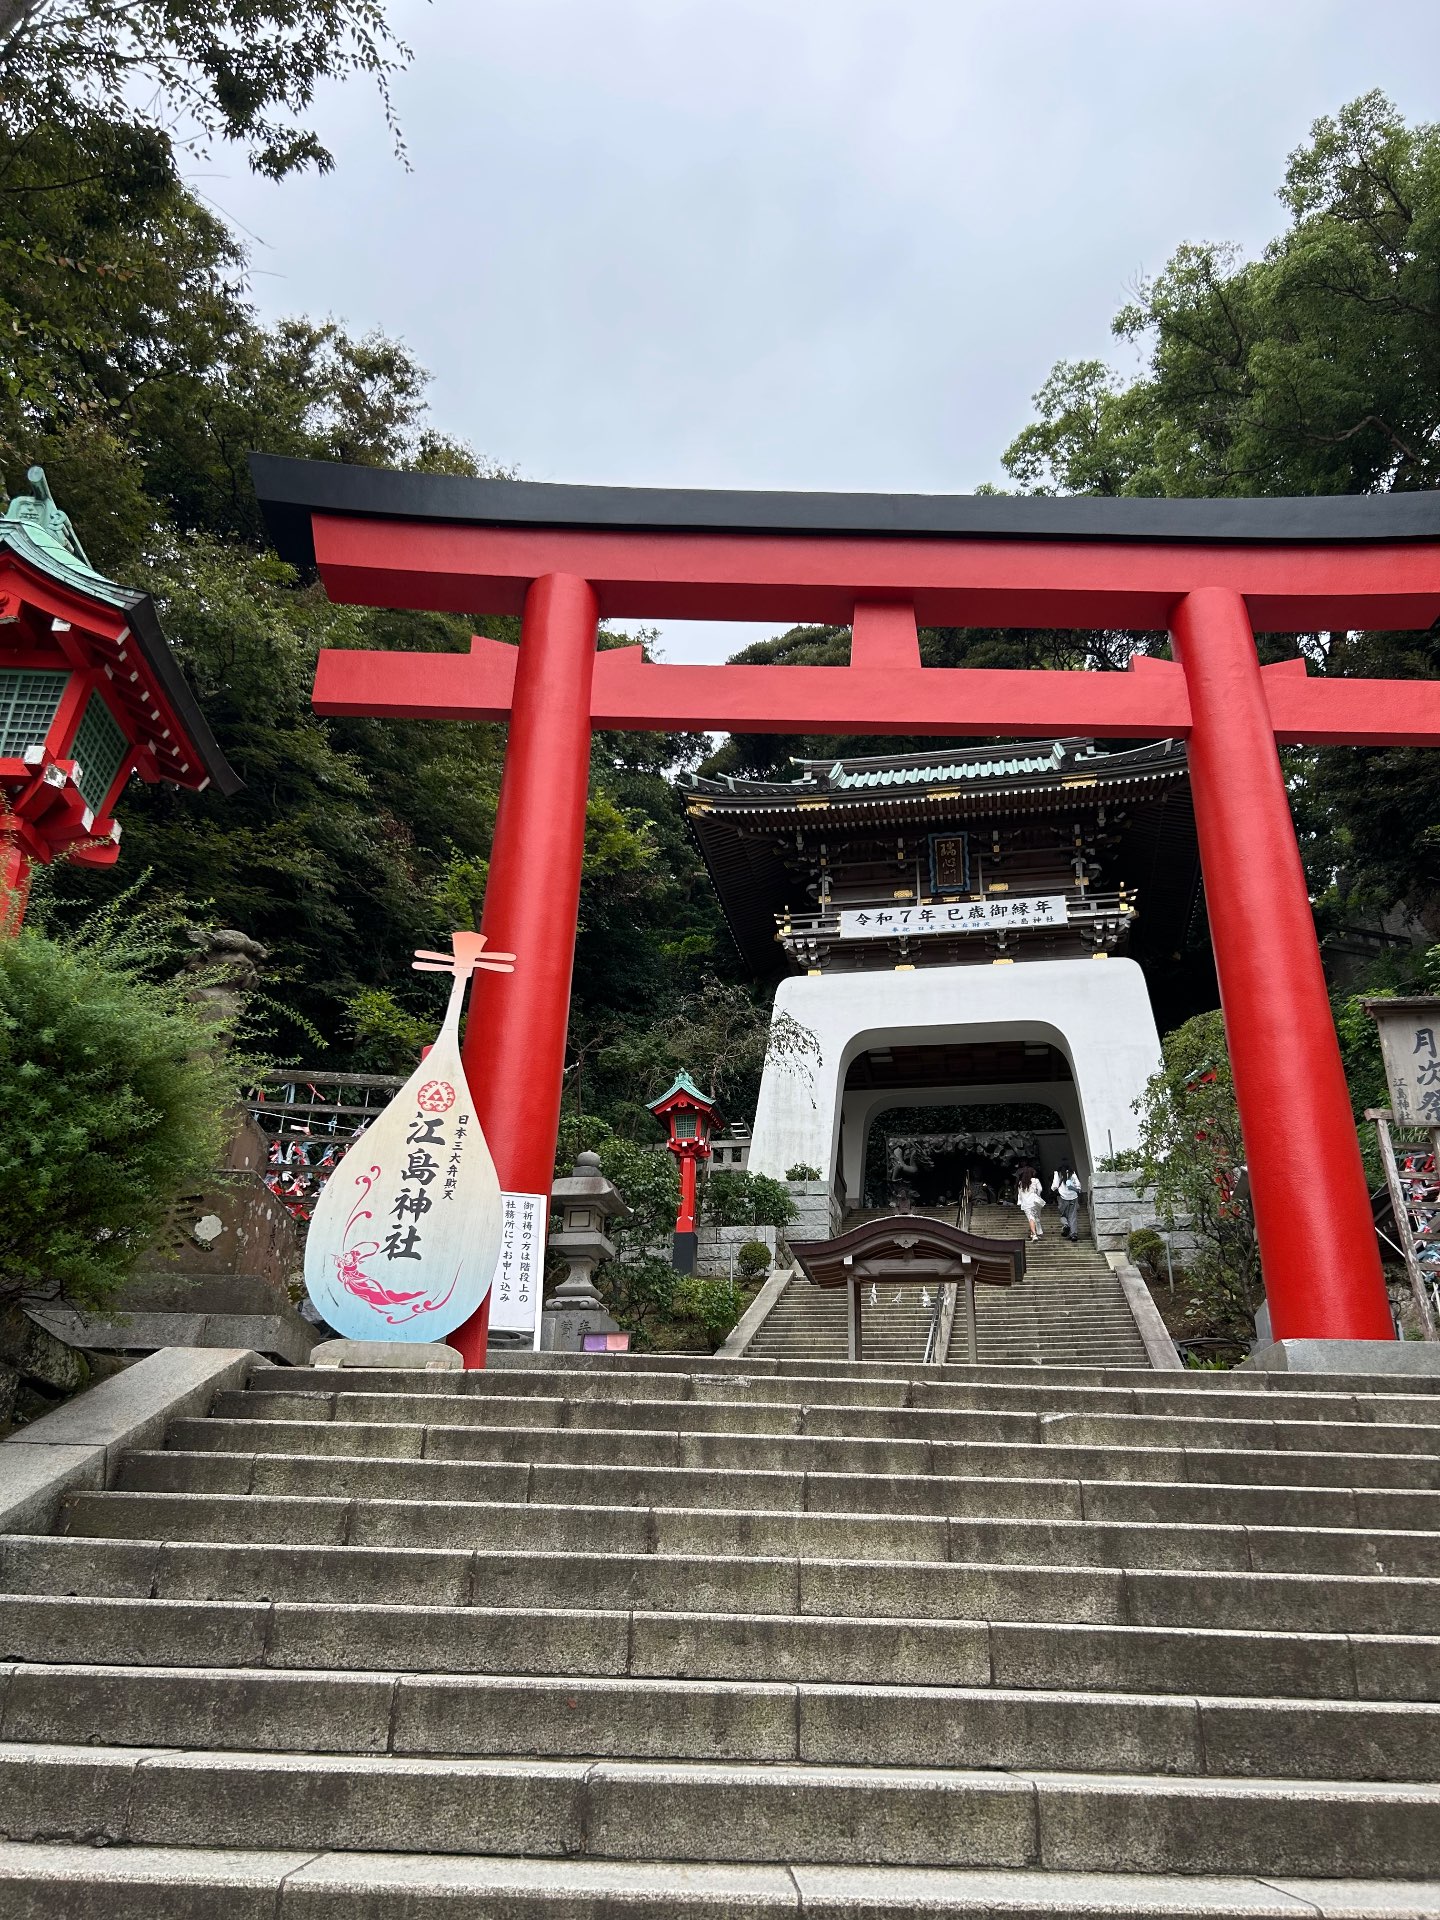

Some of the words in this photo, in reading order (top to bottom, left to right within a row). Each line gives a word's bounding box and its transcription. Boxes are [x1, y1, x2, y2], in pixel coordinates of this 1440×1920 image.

[1392, 1077, 1413, 1121] 江島神社
[380, 1111, 446, 1261] 江島神社
[442, 1114, 470, 1201] 日本三大弁財天
[499, 1199, 517, 1302] 社務所にてお申し込み
[518, 1200, 535, 1303] 御祈祷の方は階段上の
